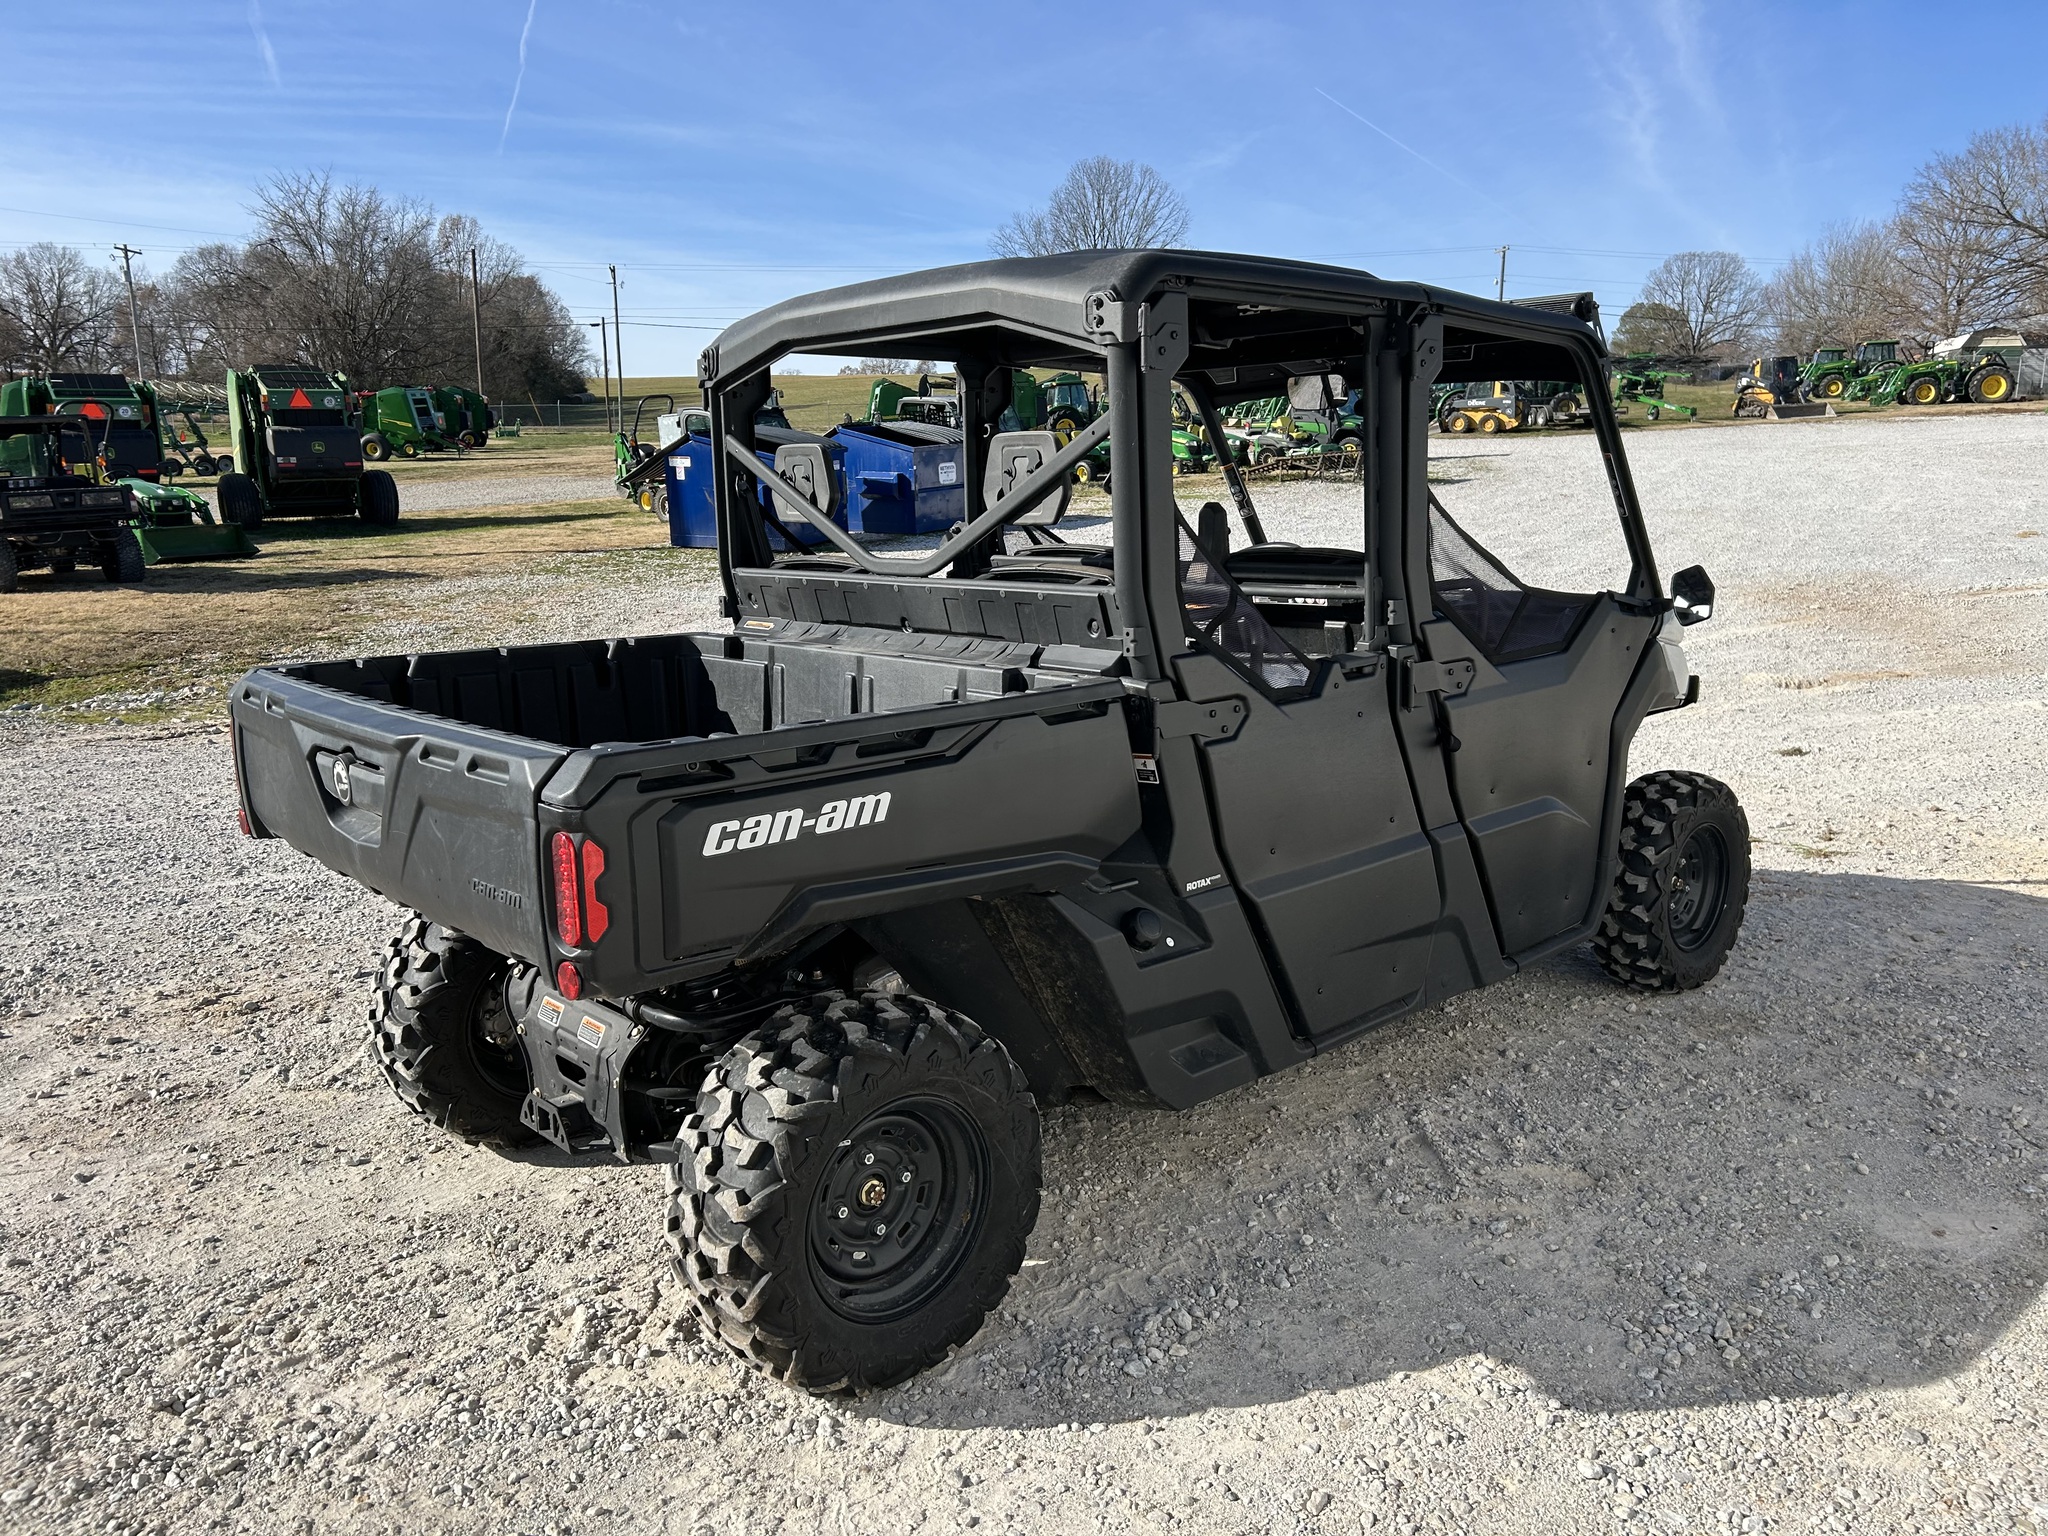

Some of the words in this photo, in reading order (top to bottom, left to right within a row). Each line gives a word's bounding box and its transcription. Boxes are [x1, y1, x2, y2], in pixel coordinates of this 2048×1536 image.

[702, 791, 892, 857] can-am
[471, 878, 522, 909] can-am
[1186, 877, 1211, 891] ROTAX
